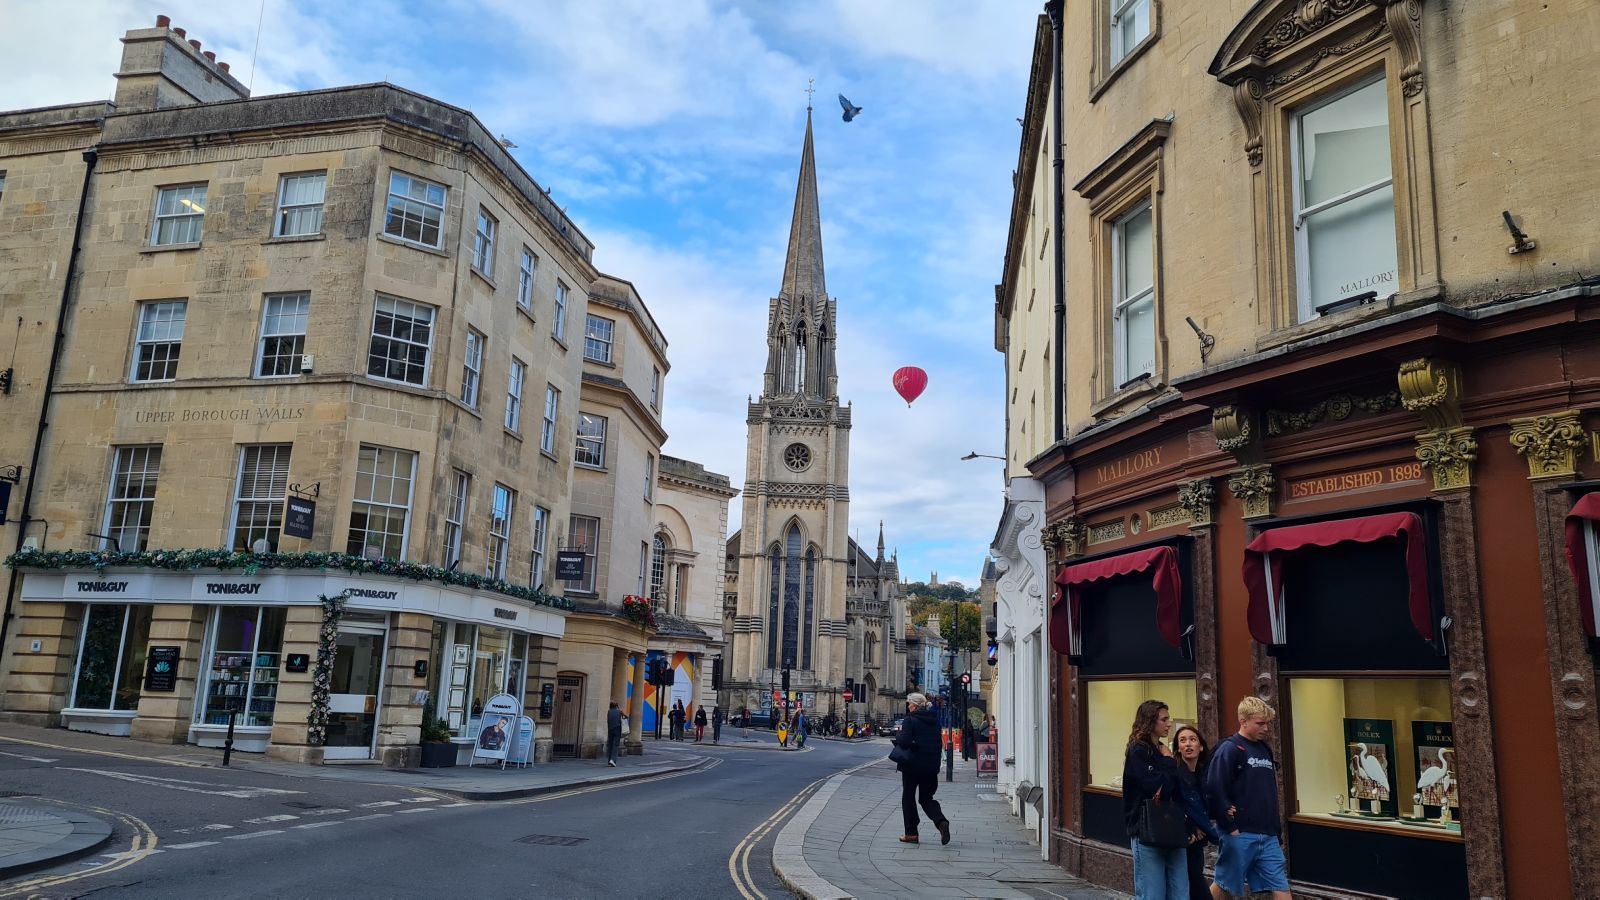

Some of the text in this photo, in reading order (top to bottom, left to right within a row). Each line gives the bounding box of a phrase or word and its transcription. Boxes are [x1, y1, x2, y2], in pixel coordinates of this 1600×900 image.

[1340, 270, 1394, 294] MALLORY
[136, 407, 305, 423] UPPER BOROUGH WALLS
[1097, 446, 1163, 484] MALLORY
[1292, 463, 1422, 497] ESTABLISHED 1898
[77, 581, 129, 592] TONI&GUY
[206, 583, 261, 594] TONI&GUY
